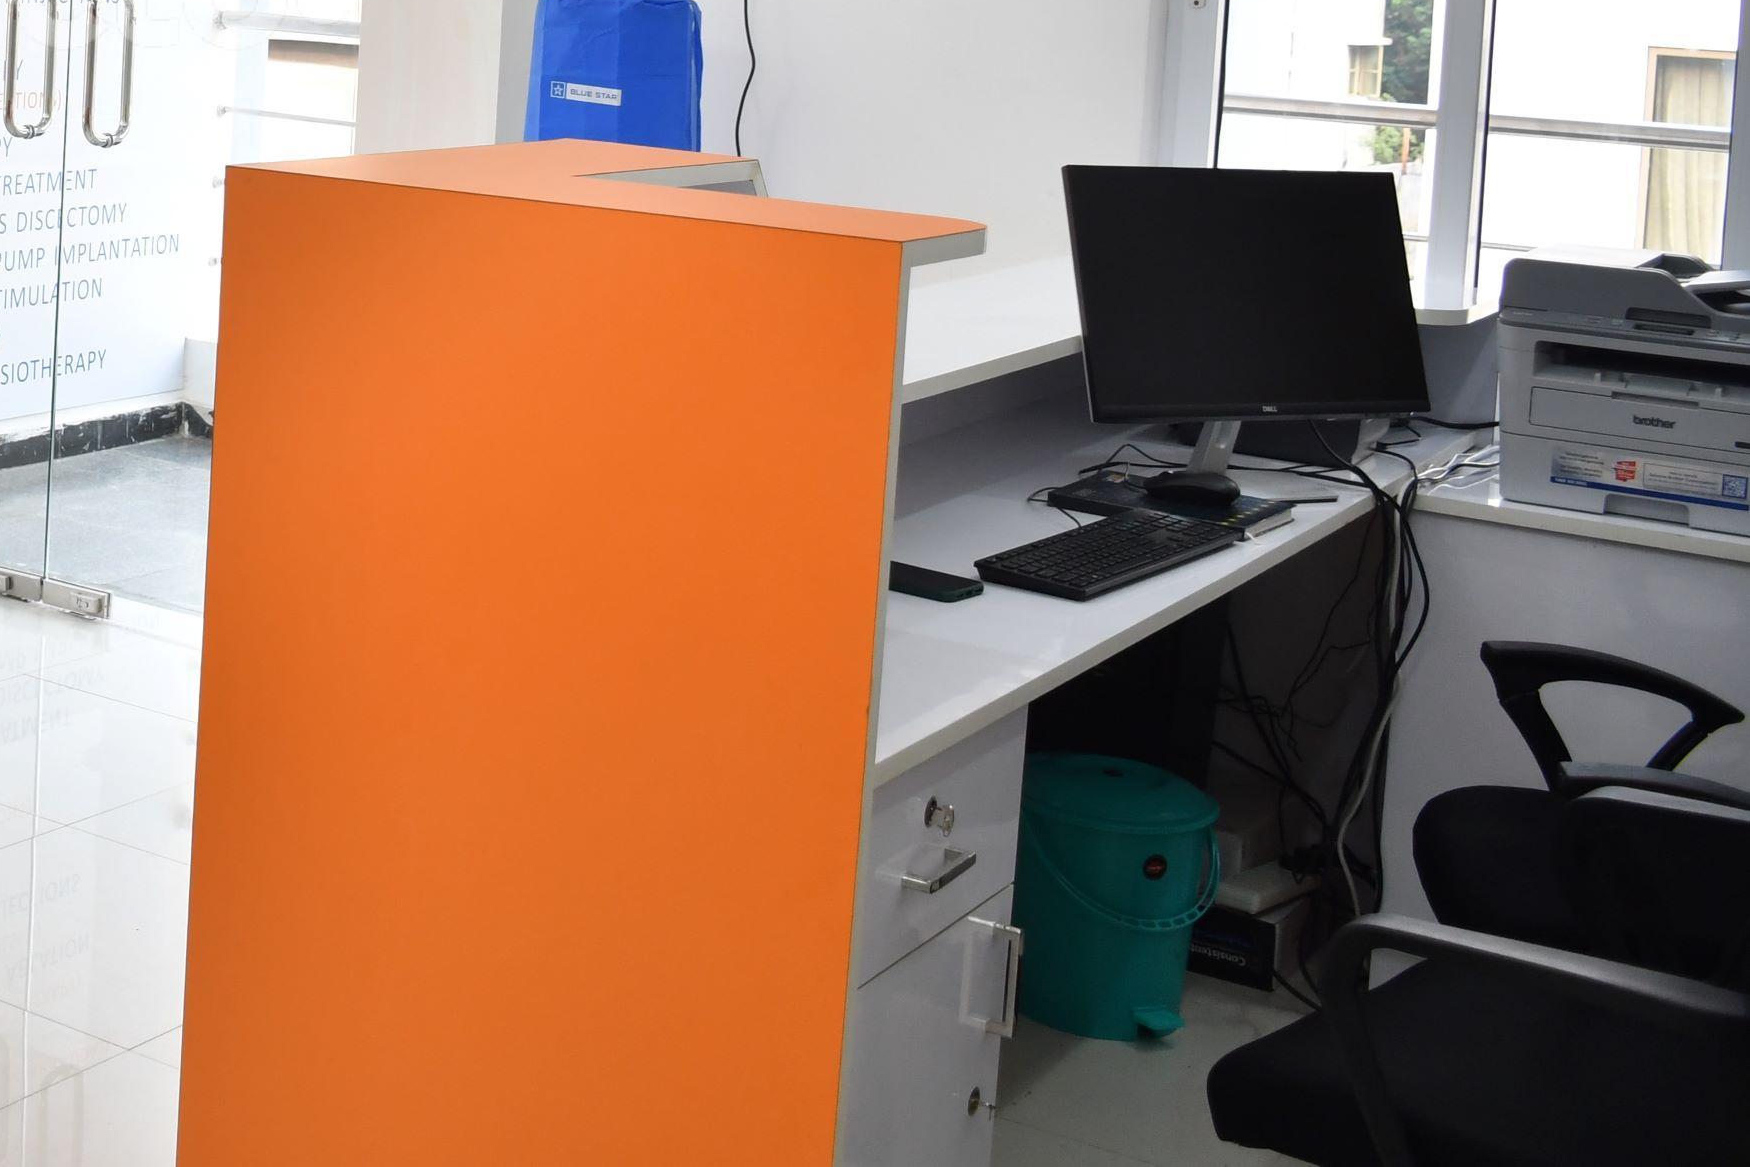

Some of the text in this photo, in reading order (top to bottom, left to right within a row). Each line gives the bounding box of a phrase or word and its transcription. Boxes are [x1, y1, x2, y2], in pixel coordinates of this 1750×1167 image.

[570, 88, 618, 100] BLUE STAR
[54, 234, 180, 266] IMPLANTATION
[1633, 415, 1676, 429] brother
